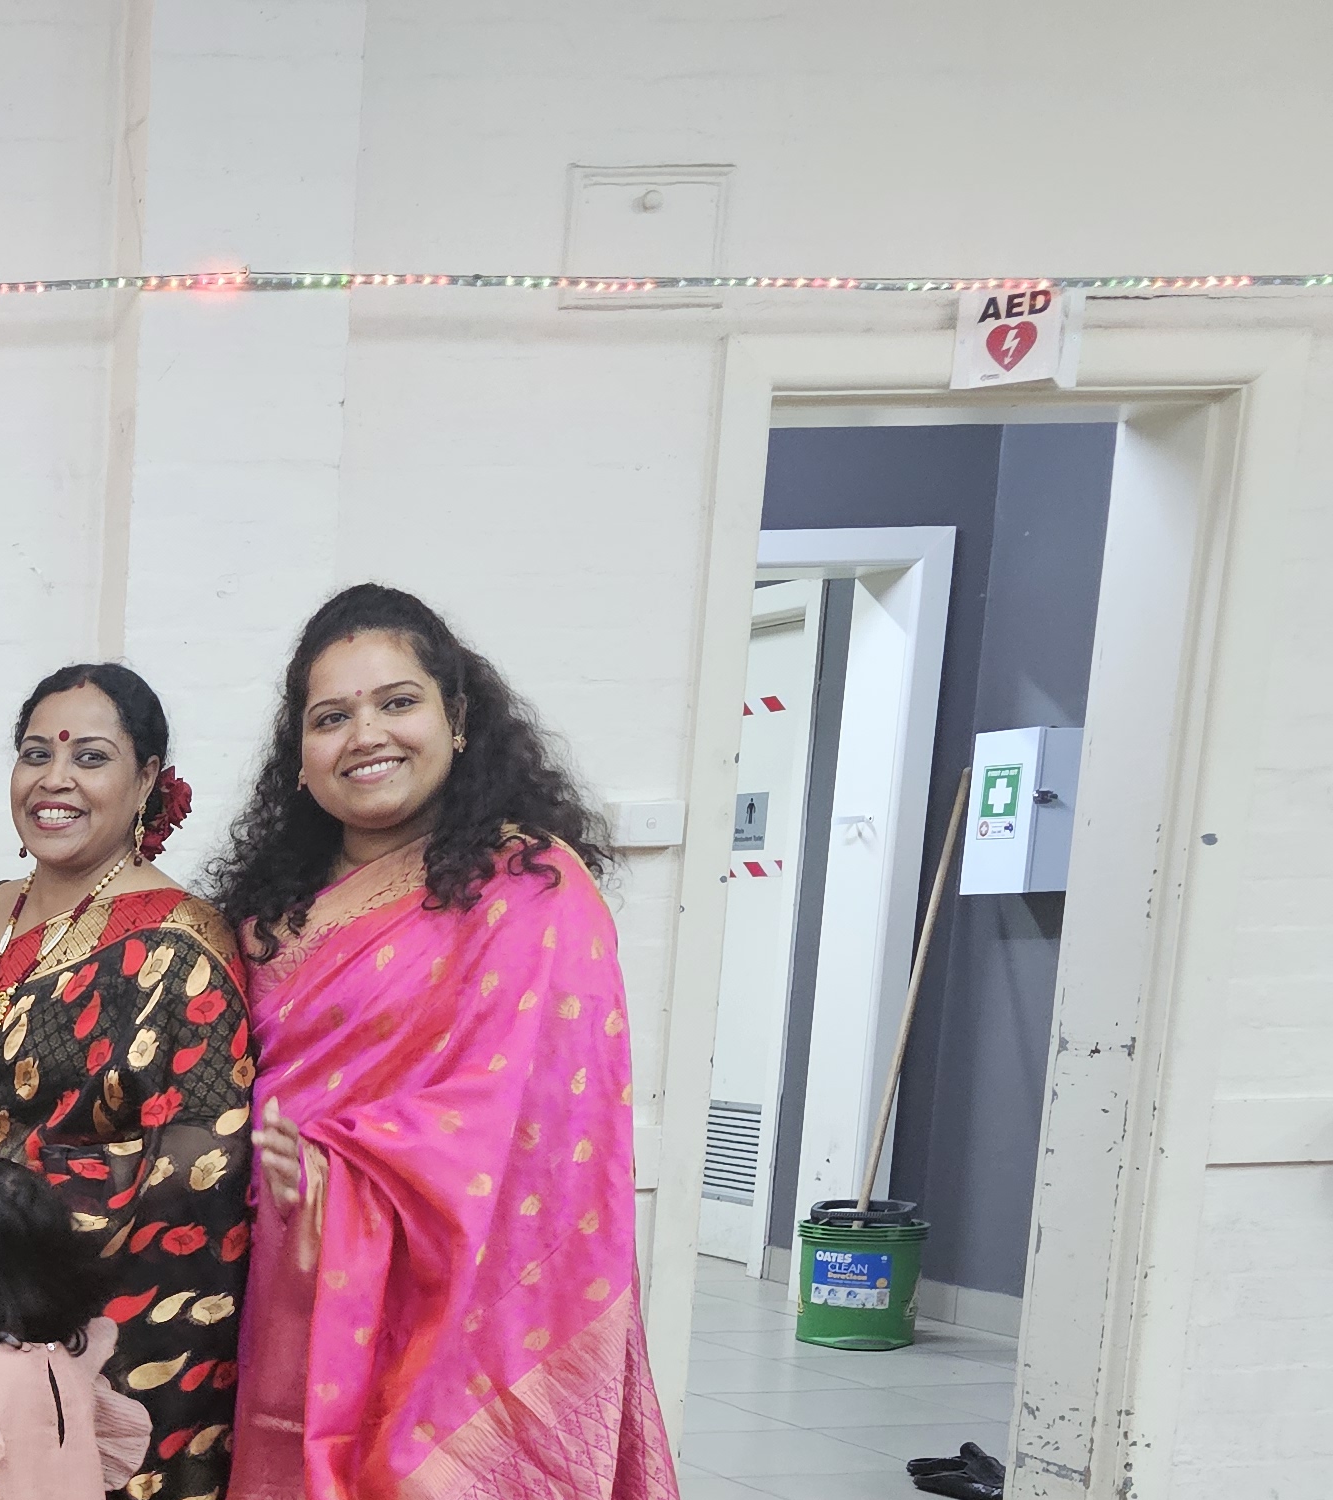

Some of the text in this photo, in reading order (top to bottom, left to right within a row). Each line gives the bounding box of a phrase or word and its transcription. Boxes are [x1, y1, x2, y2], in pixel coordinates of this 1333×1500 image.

[977, 289, 1052, 324] AED
[816, 1250, 853, 1264] OATES
[827, 1262, 869, 1274] CLEAN
